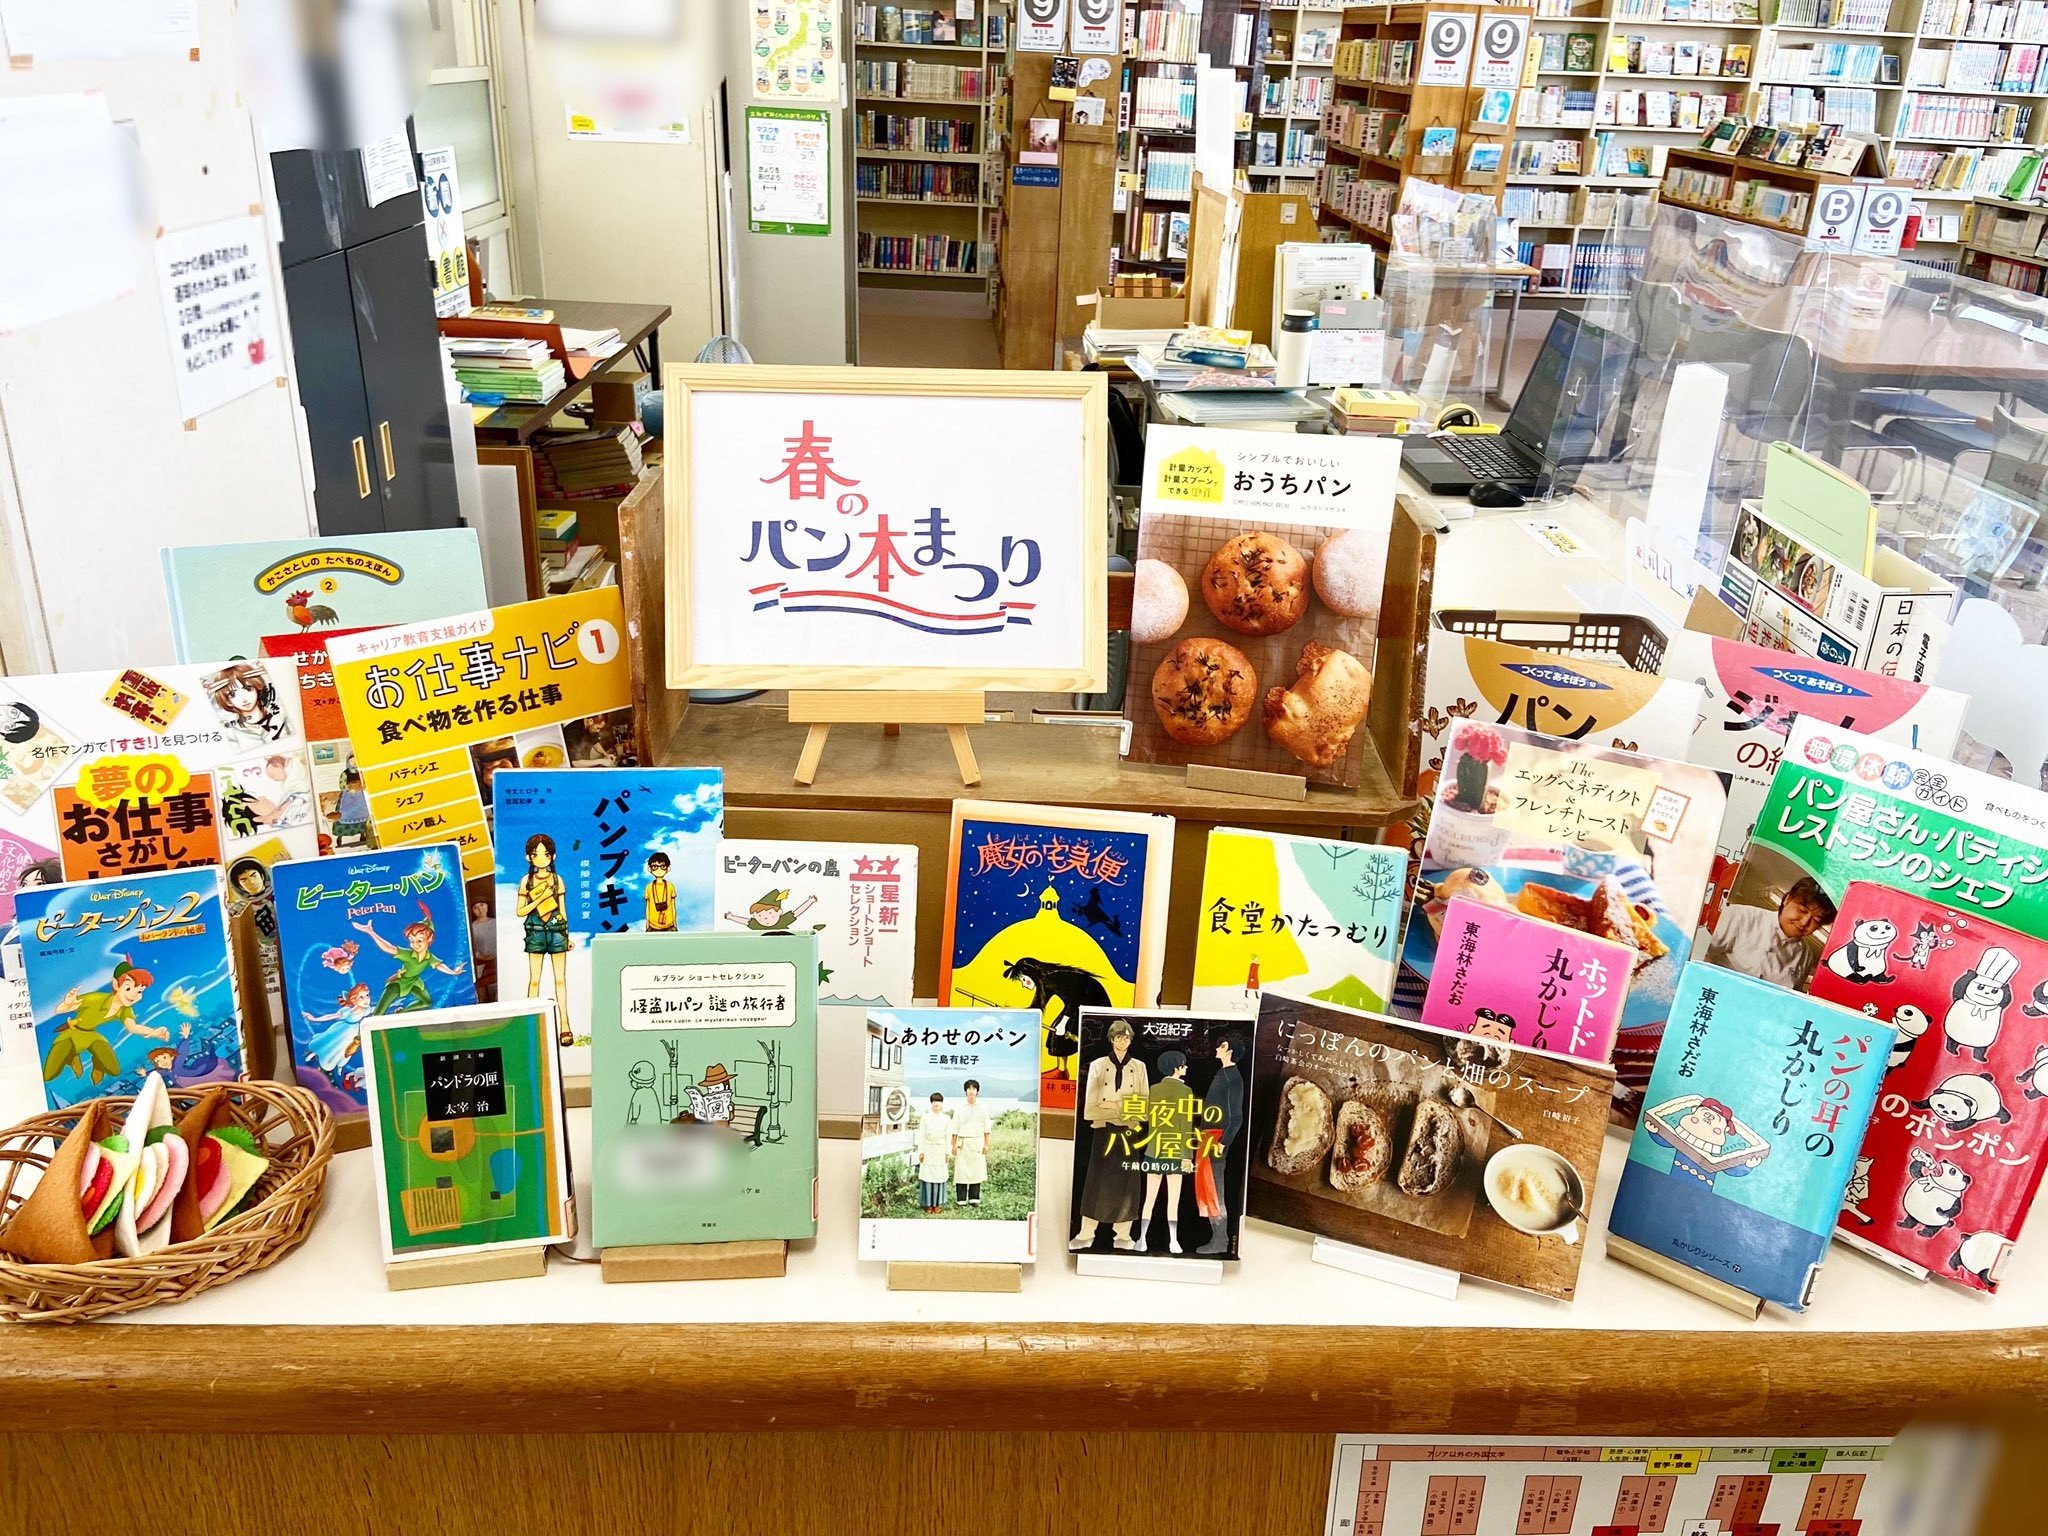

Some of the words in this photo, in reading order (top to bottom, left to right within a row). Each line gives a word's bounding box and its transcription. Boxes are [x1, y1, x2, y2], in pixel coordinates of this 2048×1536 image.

[1438, 23, 1461, 53] 9
[1491, 24, 1515, 54] 9
[1825, 193, 1850, 221] B
[1875, 196, 1898, 224] 9
[759, 419, 869, 517] 春の
[1236, 451, 1341, 468] シンプルでおいしい
[1168, 487, 1189, 495] できる
[1232, 470, 1352, 497] おうちパン
[739, 507, 1042, 602] パン本まつり
[266, 556, 321, 587] かこさとしの
[324, 554, 393, 579] たべものえほん
[323, 580, 333, 591] 2
[356, 619, 488, 656] キャリア教育支援ガイド
[590, 628, 606, 654] 1
[366, 620, 581, 710] お仕事ナビ
[1521, 665, 1586, 688] つくってあそぼう
[1773, 670, 1844, 694] つくってあそぼう
[377, 683, 563, 744] 食べ物を作る仕事
[388, 760, 440, 782] パティシエ
[1570, 761, 1596, 778] The
[1807, 739, 1911, 788] 職場体験
[90, 763, 175, 800] 夢の
[1514, 769, 1641, 807] エッグベネディクト
[395, 792, 424, 809] シェフ
[1515, 796, 1630, 834] フレンチトースト
[62, 791, 214, 845] お仕事
[402, 814, 447, 834] パン職人
[1548, 824, 1590, 843] レシピ
[97, 837, 189, 868] さがし
[592, 789, 632, 932] パンプキン
[723, 855, 840, 877] ピーターパンの島
[971, 831, 1129, 887] 魔女の宅急便
[1777, 806, 2015, 909] レストランのシェフ
[347, 906, 371, 919] Peter
[372, 903, 397, 916] Pan
[848, 883, 862, 946] セレクション
[879, 884, 900, 933] 星新一
[1207, 896, 1387, 948] 食堂かたつむり
[862, 883, 876, 968] ショートショート
[653, 974, 685, 982] ルブラン
[688, 973, 765, 981] ショートセレクション
[1447, 921, 1481, 1006] 東海林さだお
[630, 996, 703, 1014] 怪盗ルパン
[708, 994, 786, 1012] 謎の旅行者
[883, 1027, 1027, 1047] しあわせのパン
[1142, 1022, 1193, 1036] 大沼紀子
[1677, 987, 1719, 1078] 東海林さだお
[928, 1054, 980, 1065] 三島有紀子
[1278, 1019, 1590, 1104] にっぽんのパンと畑のスープ
[430, 1071, 499, 1089] パンドラの匣
[1771, 1019, 1825, 1137] 丸かじり
[445, 1101, 470, 1115] 太宰
[477, 1100, 490, 1112] 治
[1121, 1093, 1223, 1128] 真夜中の
[1804, 1033, 1874, 1159] パンの耳の
[1104, 1126, 1223, 1160] パン屋さん
[1671, 1237, 1731, 1269] 丸かじりシリーズ
[1427, 1450, 1506, 1458] アジア以外の外国文学
